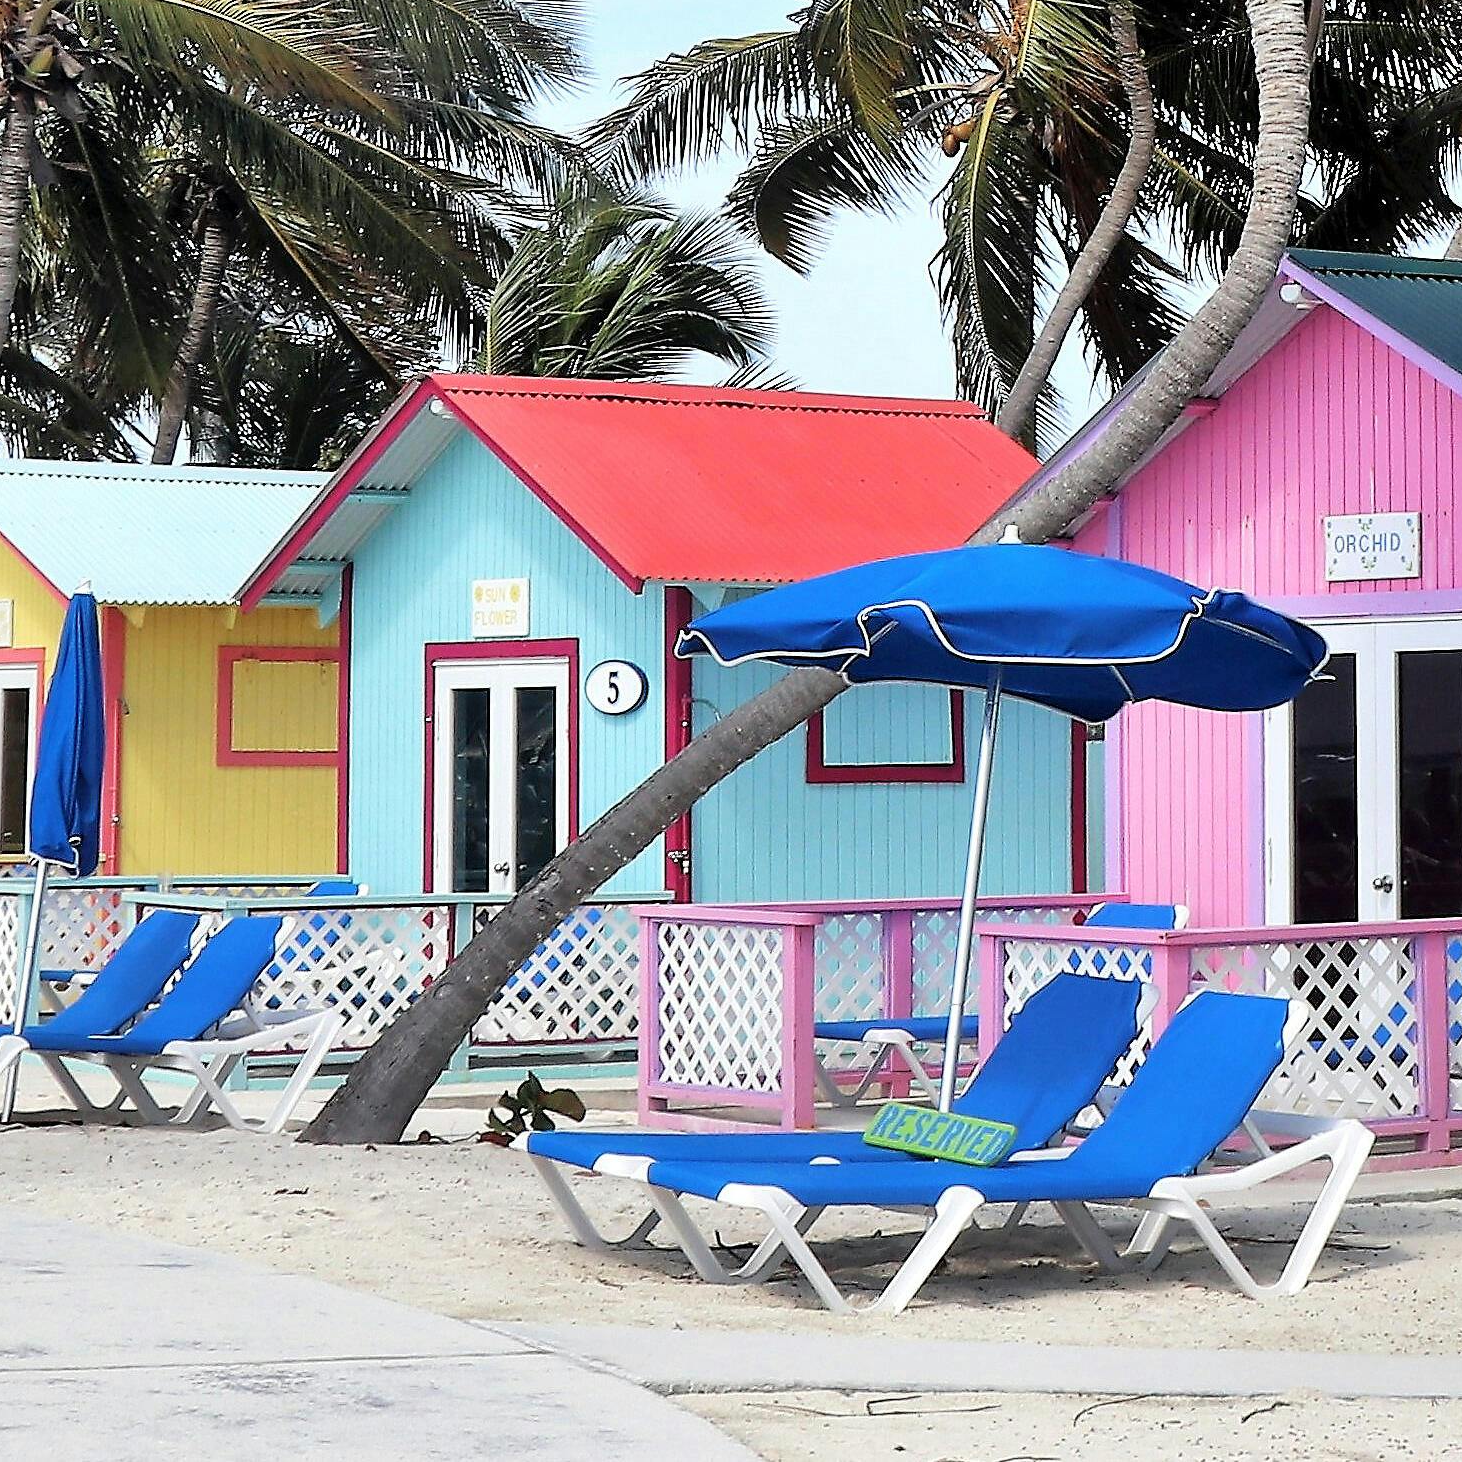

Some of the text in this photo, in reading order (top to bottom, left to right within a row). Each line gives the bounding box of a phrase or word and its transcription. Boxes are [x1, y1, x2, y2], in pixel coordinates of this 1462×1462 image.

[1334, 532, 1401, 554] ORCHID
[484, 588, 506, 603] SUN
[474, 610, 517, 626] FLOWER
[607, 671, 619, 704] 5
[870, 1105, 1011, 1163] RESERVED
